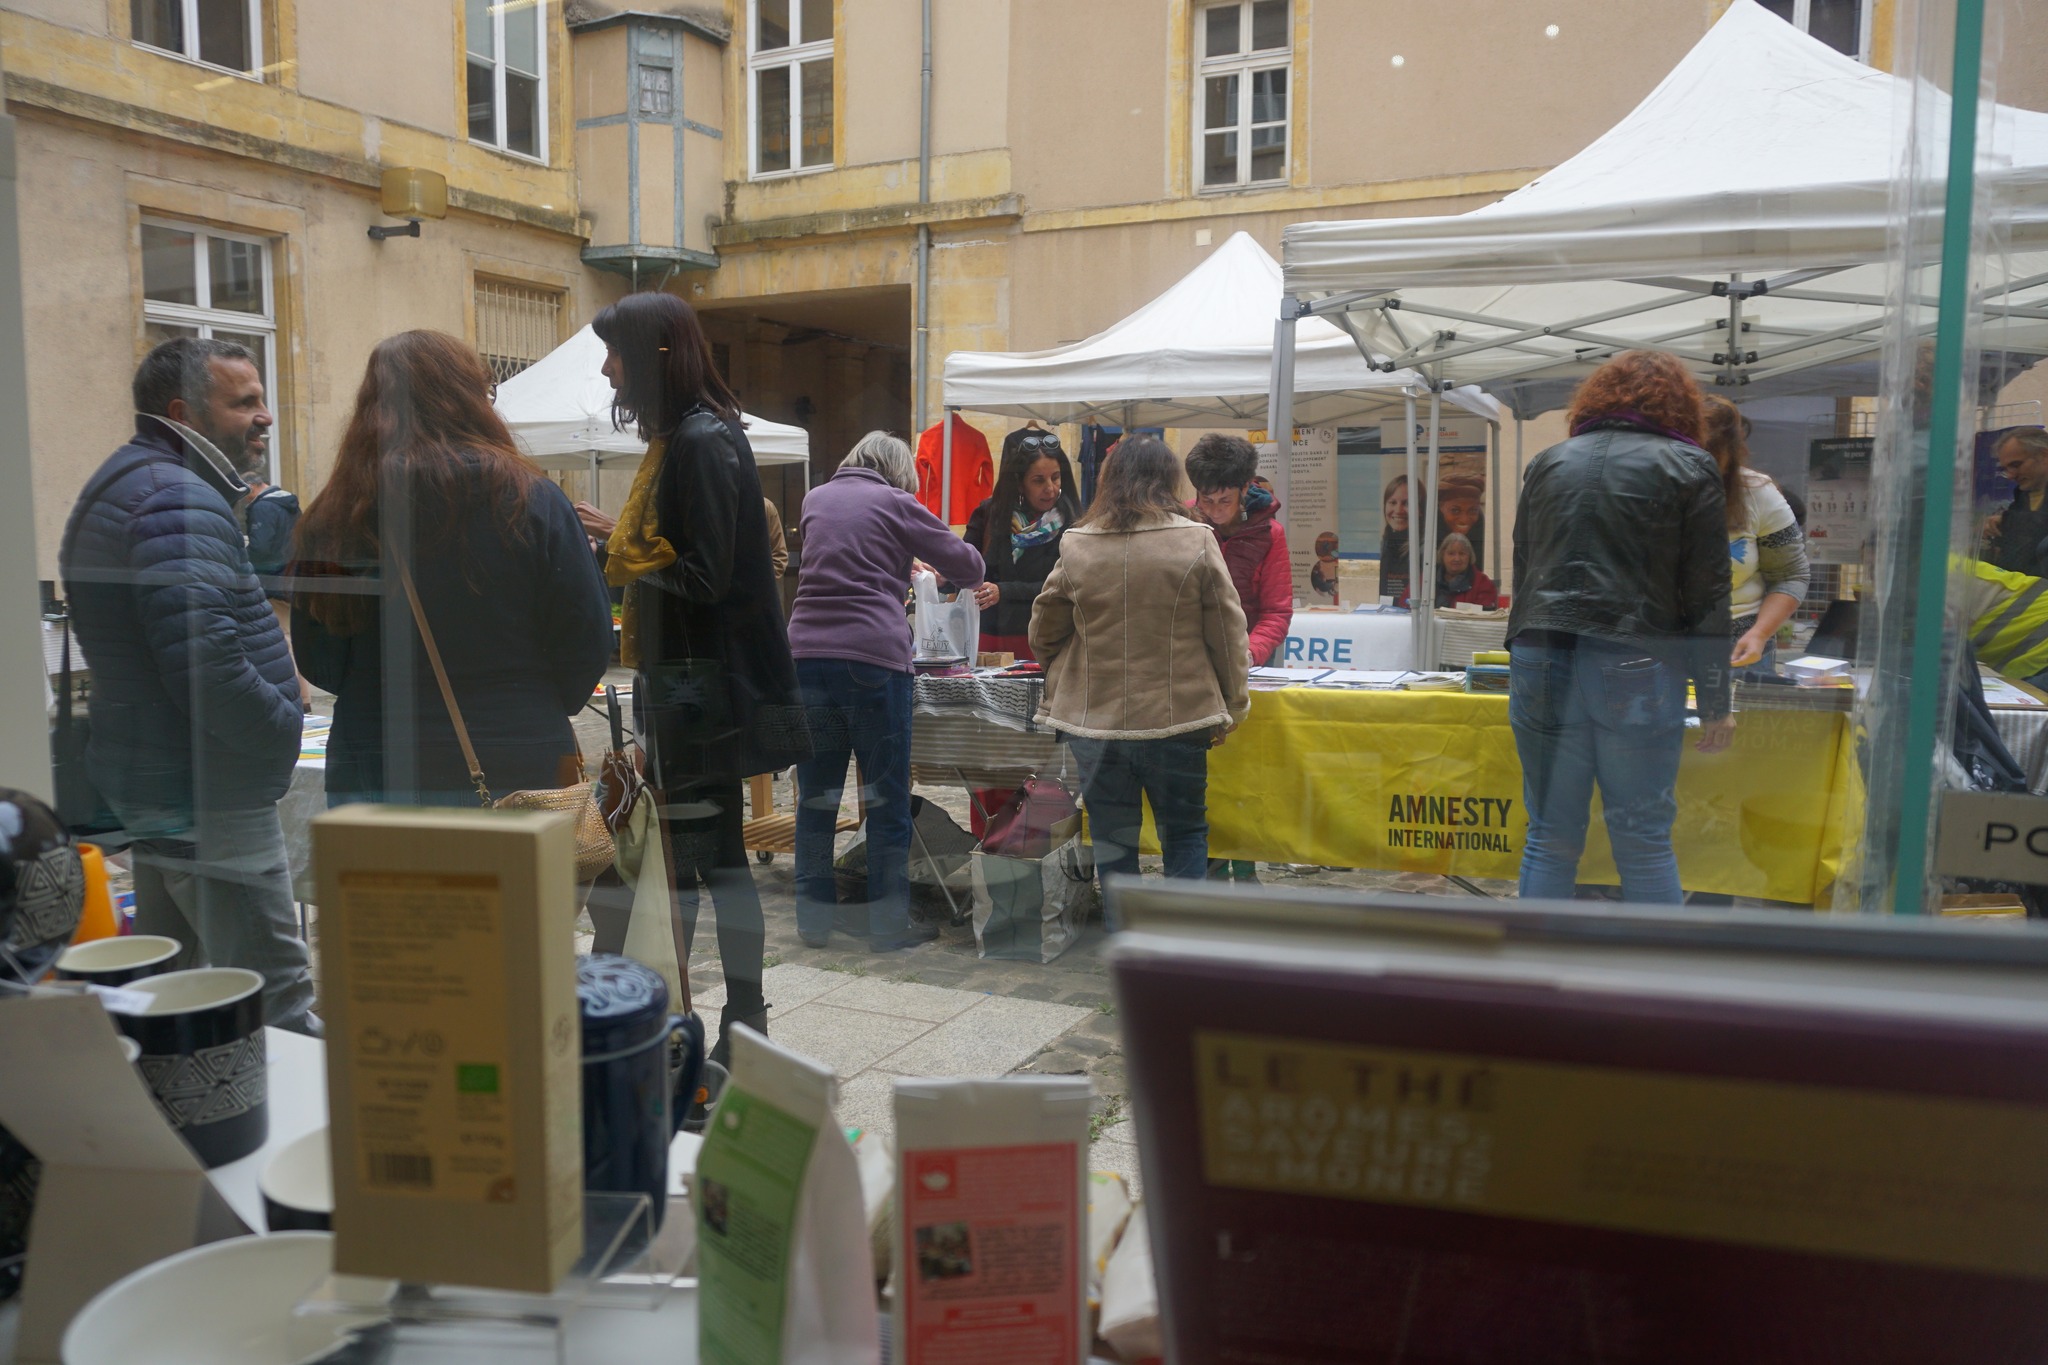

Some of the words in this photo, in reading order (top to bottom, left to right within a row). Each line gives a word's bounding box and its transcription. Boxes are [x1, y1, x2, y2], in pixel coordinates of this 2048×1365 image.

[1284, 636, 1353, 664] RRE
[1388, 794, 1513, 828] AMNESTY
[1388, 829, 1512, 853] INTERNATIONAL
[1214, 1045, 1304, 1095] LE
[1275, 1158, 1488, 1203] MONDE
